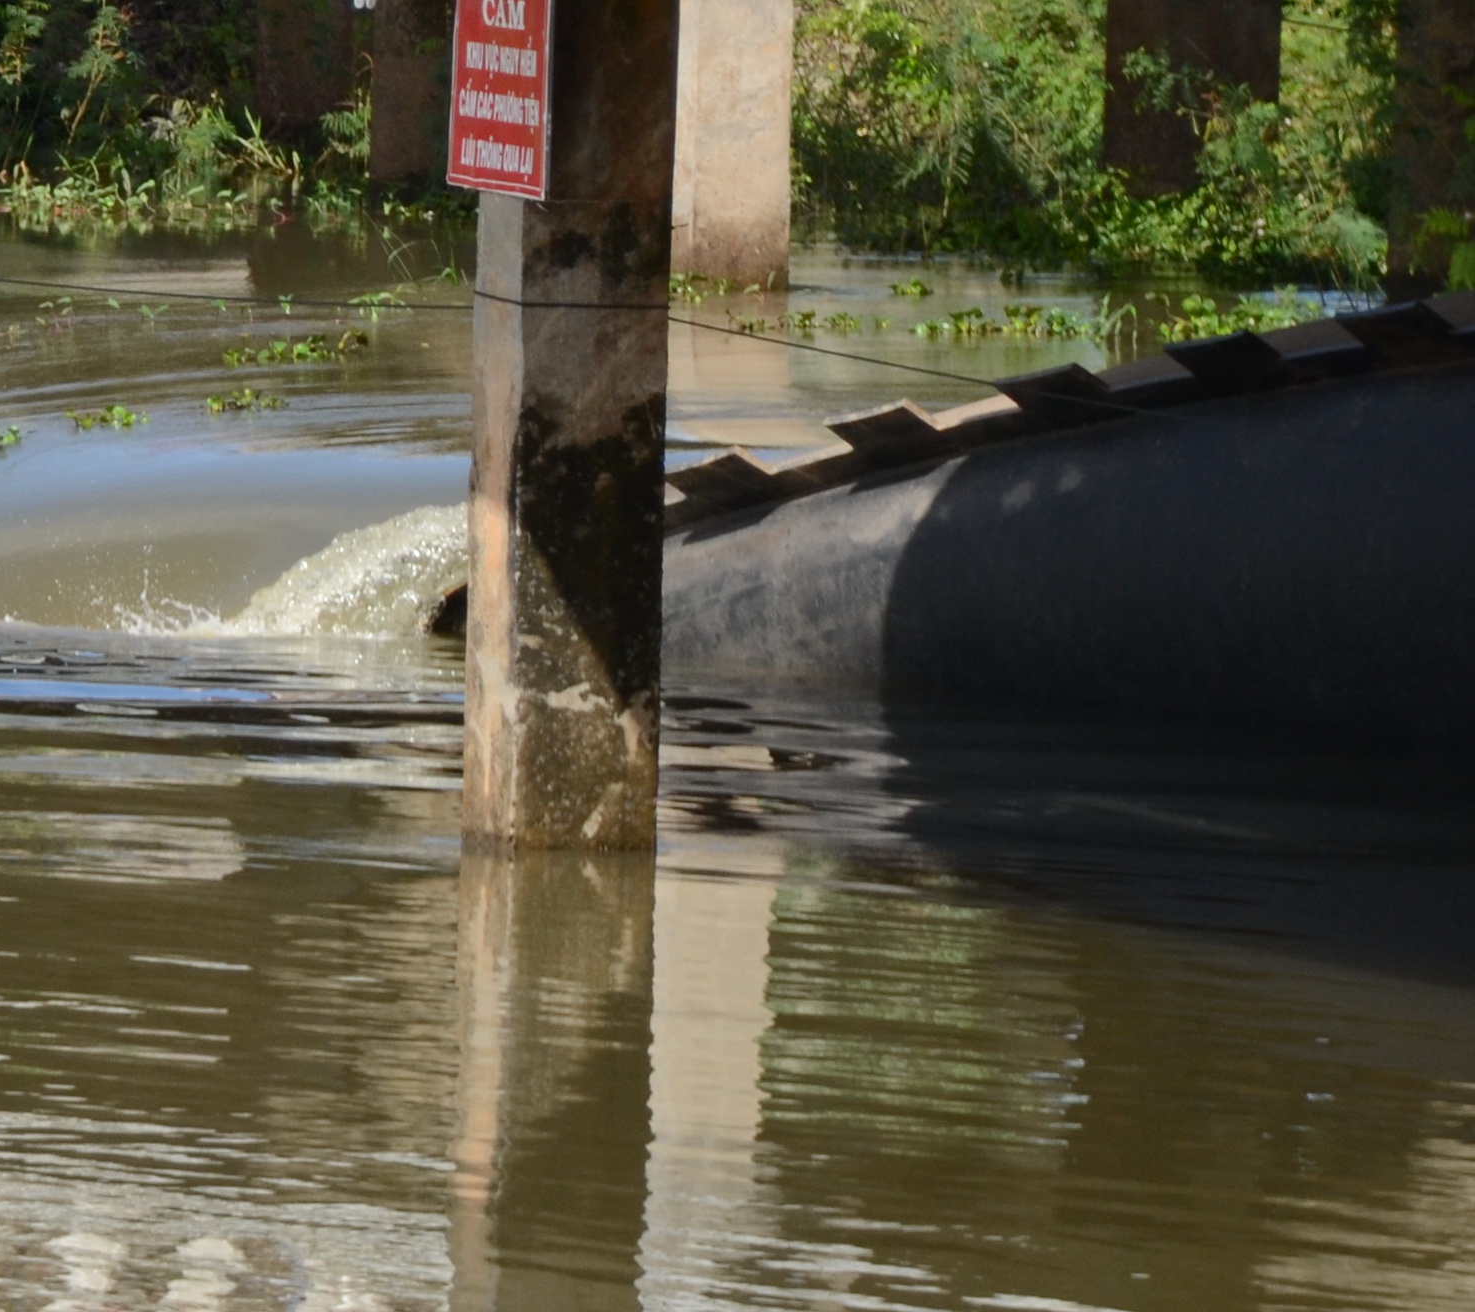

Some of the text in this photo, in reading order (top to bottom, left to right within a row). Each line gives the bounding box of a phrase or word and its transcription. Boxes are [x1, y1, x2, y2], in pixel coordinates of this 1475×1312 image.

[466, 41, 483, 70] KHU
[485, 40, 500, 79] VỰC
[500, 46, 520, 75] NGUY
[459, 78, 540, 134] CẤM CÁC PHƯƠNG TIỆN
[460, 134, 534, 183] LƯU THÔNG QUA LẠI
